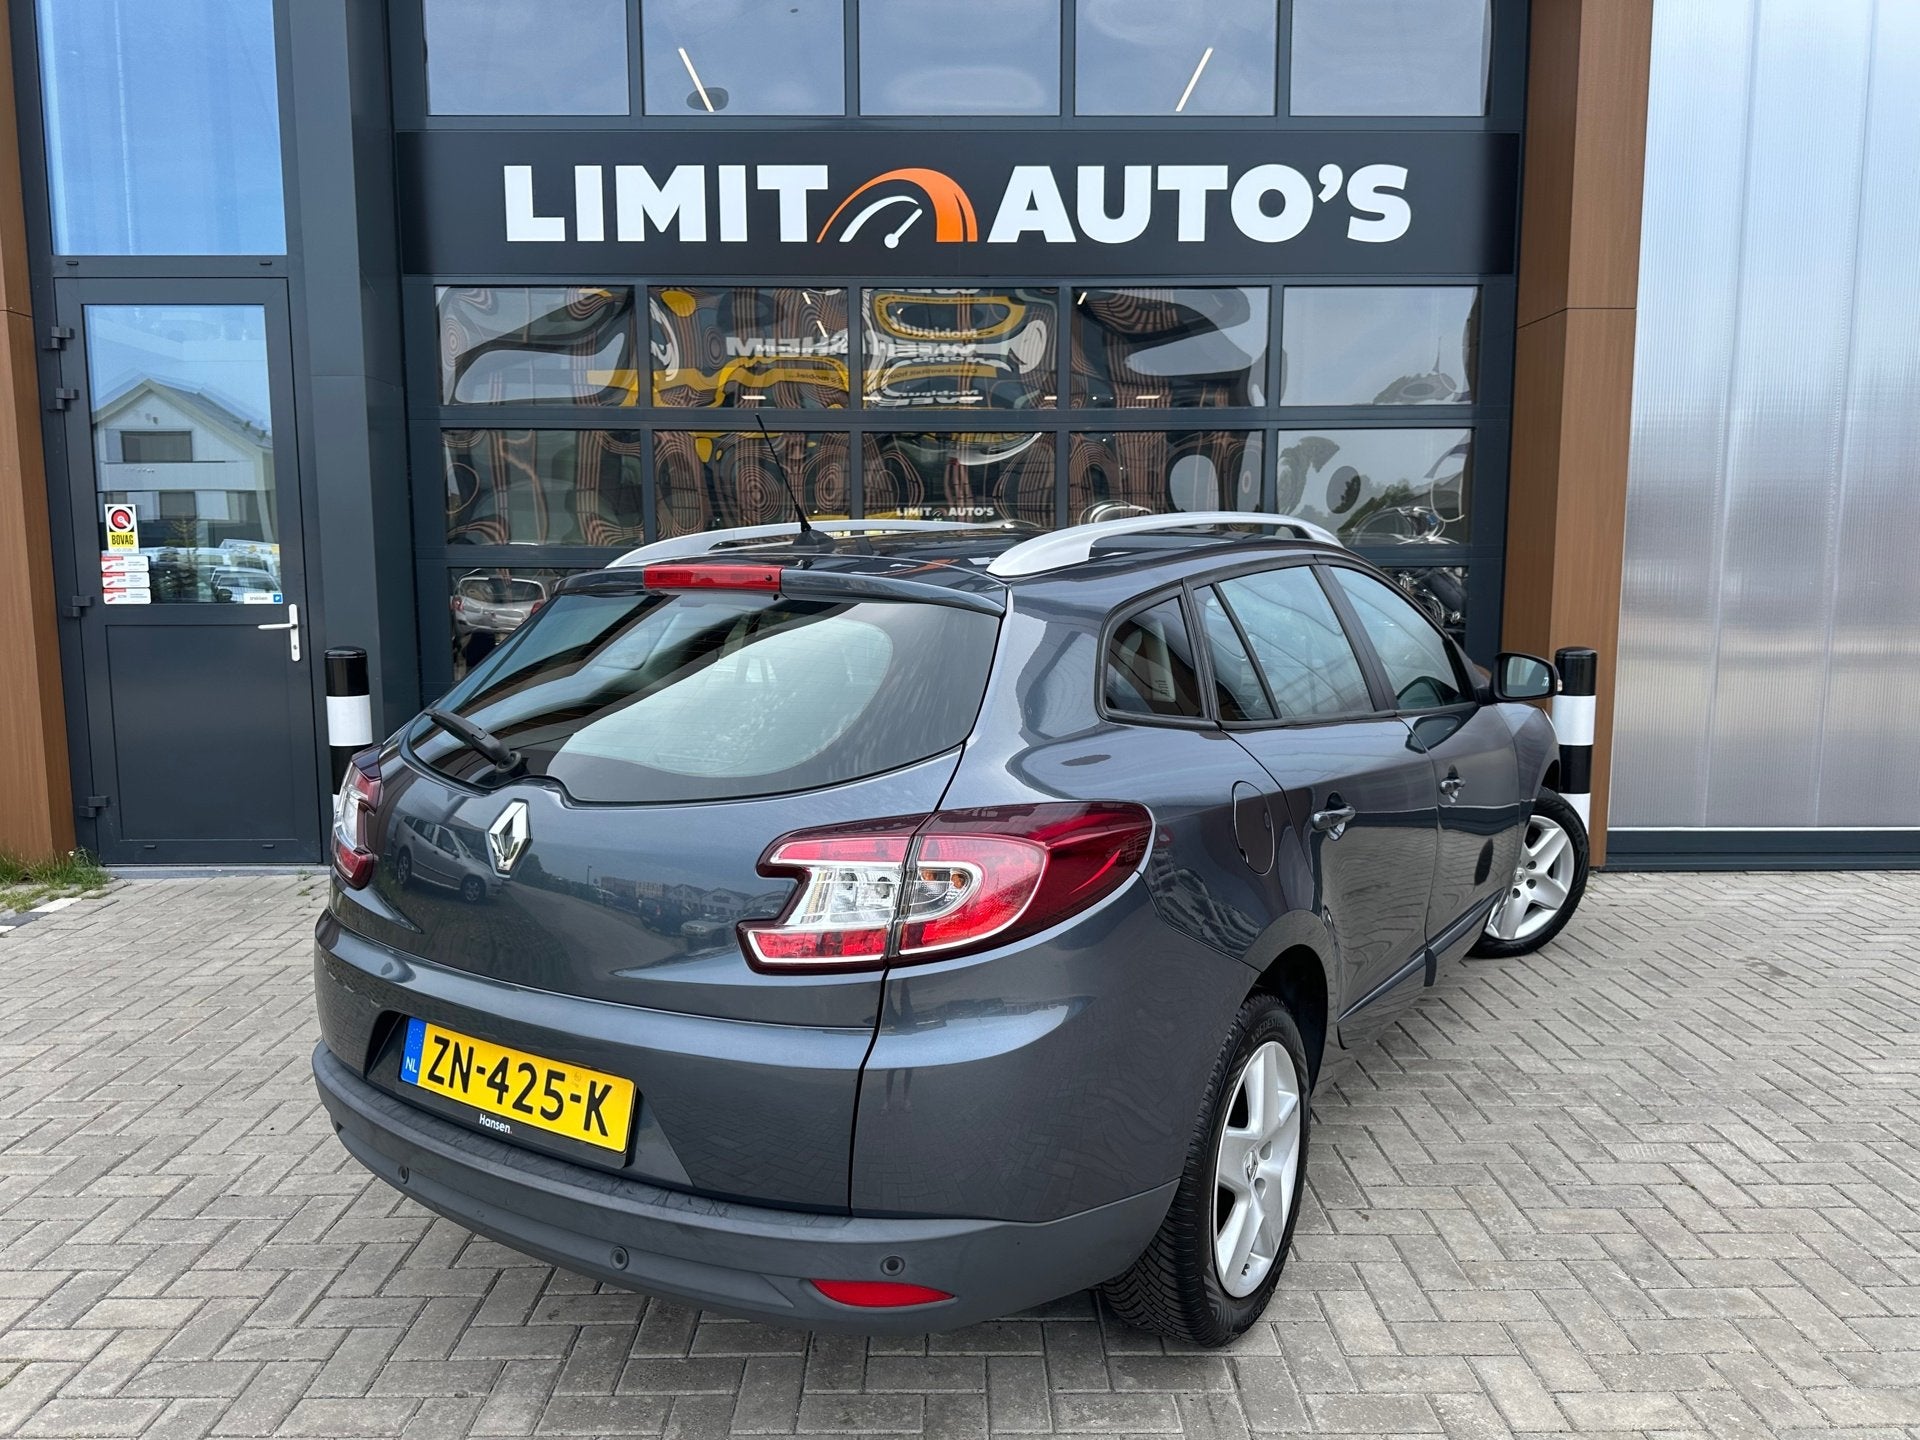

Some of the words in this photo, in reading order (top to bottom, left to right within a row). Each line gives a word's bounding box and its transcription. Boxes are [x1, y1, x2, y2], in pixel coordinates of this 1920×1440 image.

[503, 164, 828, 244] LIMIT
[987, 163, 1412, 245] AUTO'S
[896, 507, 932, 516] LIMIT
[948, 507, 995, 516] AUTO'S
[111, 534, 134, 546] BOVAG
[405, 1056, 418, 1073] NL
[427, 1034, 613, 1138] ZN-425-K
